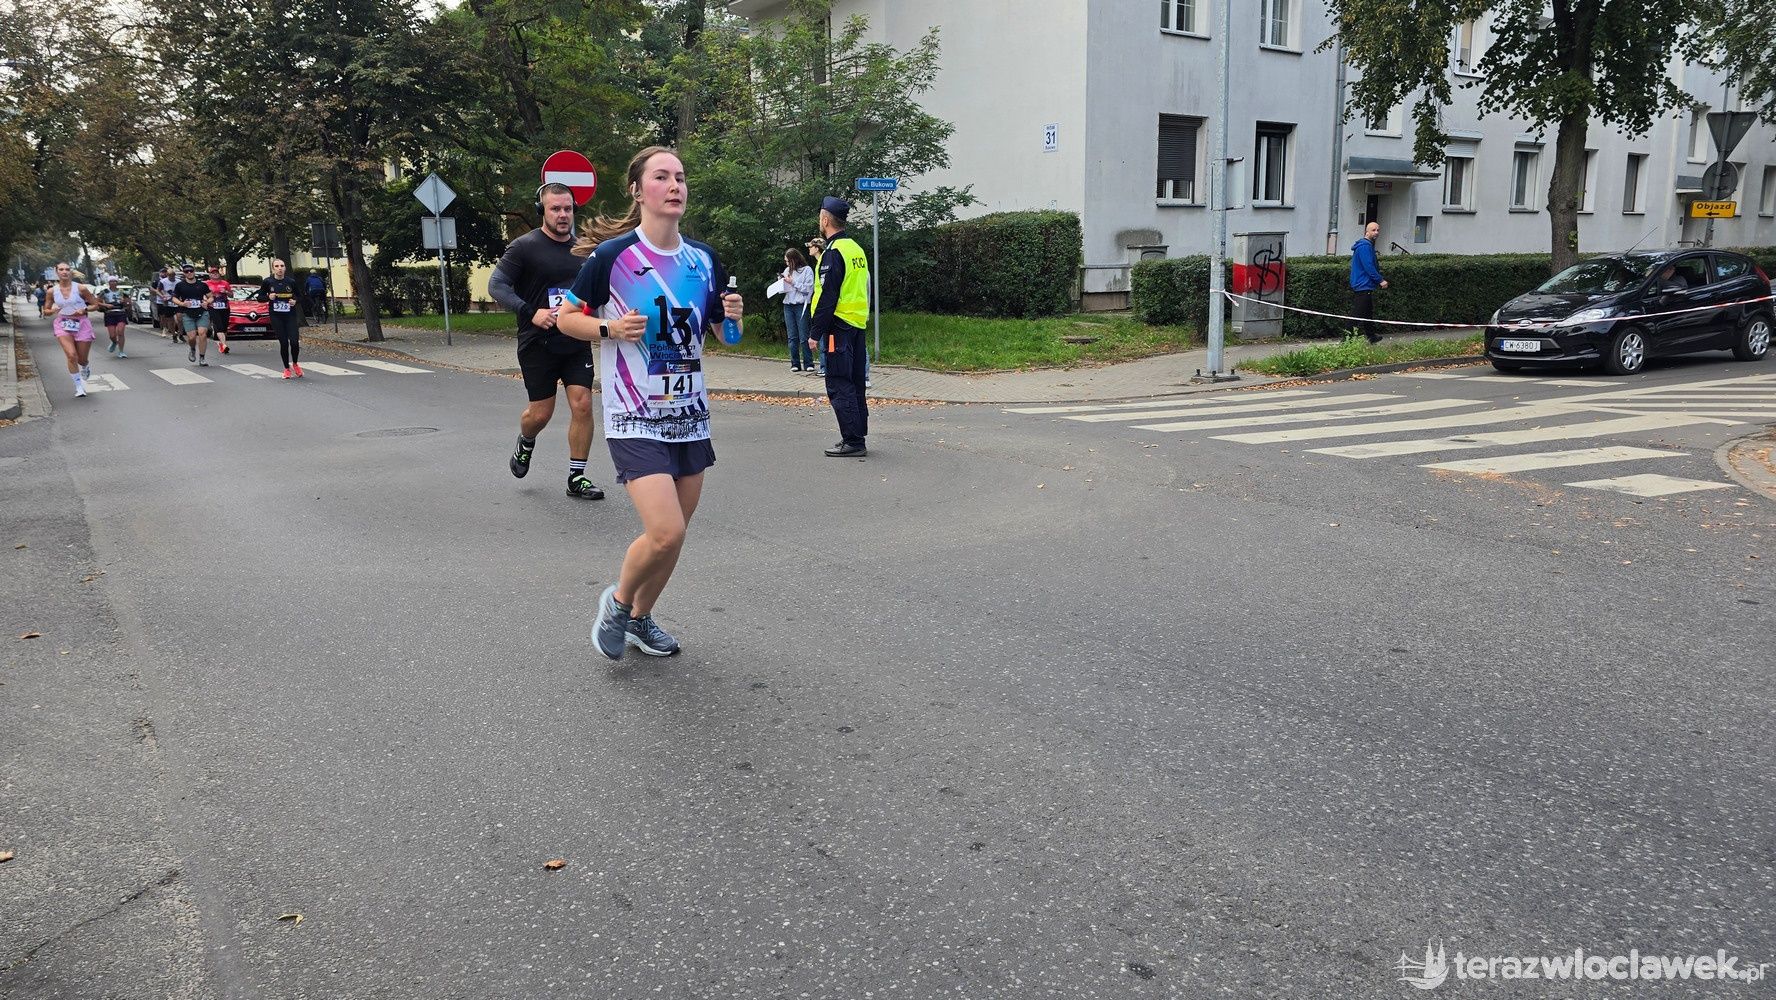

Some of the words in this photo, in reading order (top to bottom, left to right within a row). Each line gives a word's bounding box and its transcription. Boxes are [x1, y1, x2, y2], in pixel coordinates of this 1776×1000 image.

[1045, 131, 1056, 145] 31
[654, 295, 694, 350] 13
[1504, 341, 1514, 349] CW
[662, 374, 693, 395] 141
